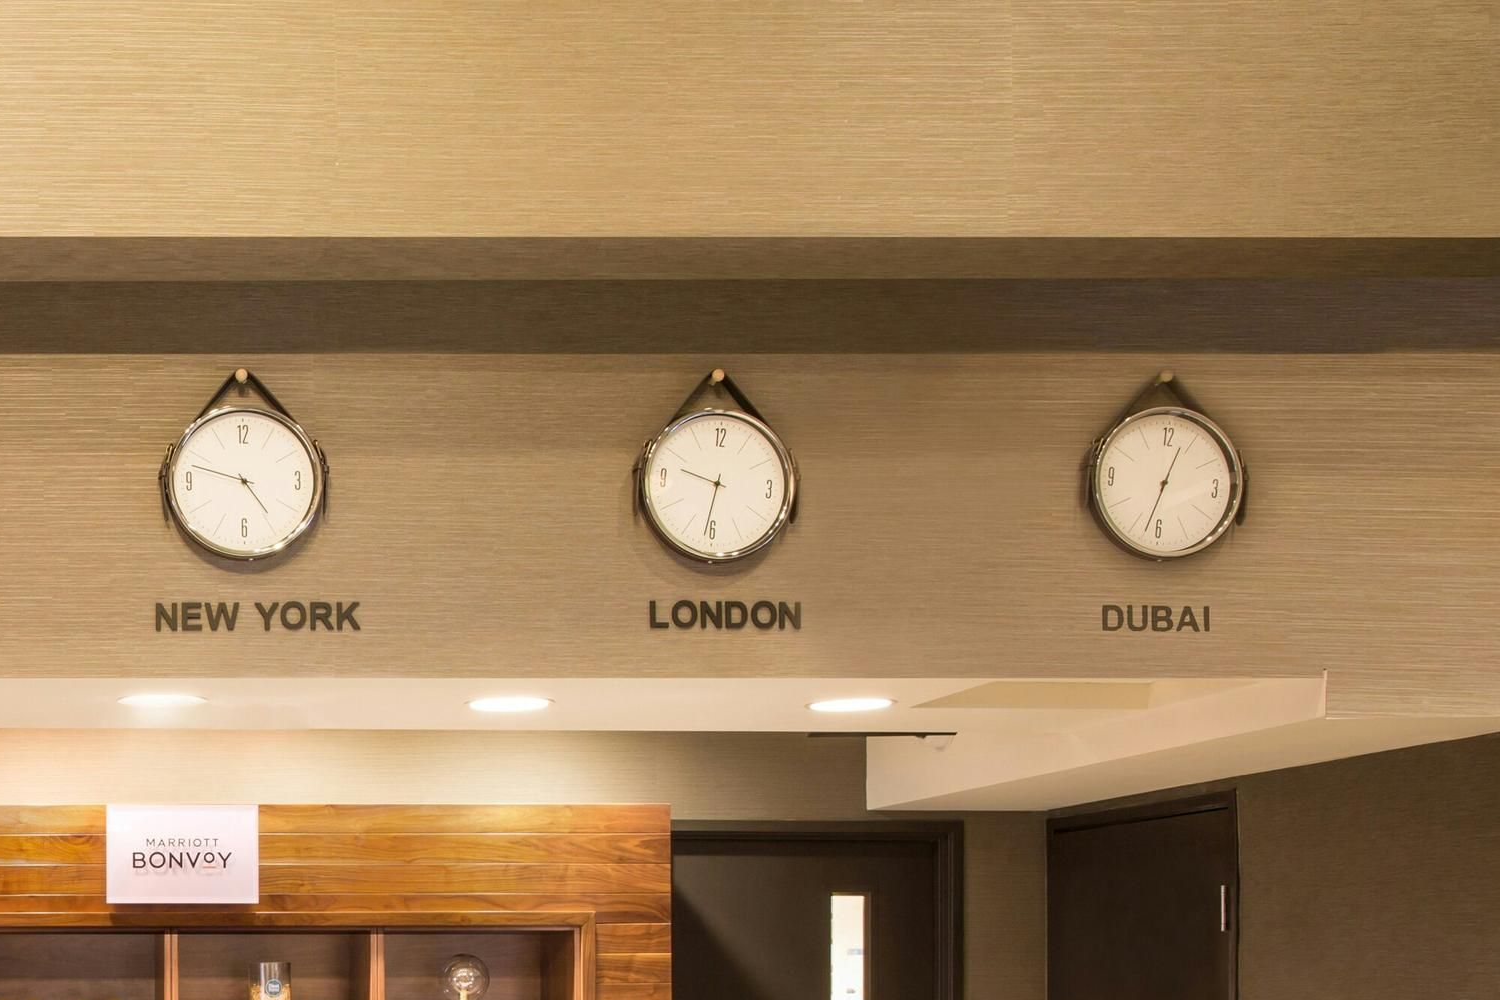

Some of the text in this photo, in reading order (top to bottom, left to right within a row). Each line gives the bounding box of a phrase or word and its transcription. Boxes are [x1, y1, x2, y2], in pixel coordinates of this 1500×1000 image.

[237, 425, 248, 444] 12
[716, 428, 726, 447] 12
[1164, 427, 1174, 446] 12
[186, 471, 192, 491] 9
[295, 471, 301, 490] 3
[661, 468, 667, 487] 9
[1108, 467, 1114, 486] 9
[766, 480, 772, 499] 3
[1211, 479, 1218, 498] 3
[242, 518, 247, 537] 6
[710, 520, 716, 539] 6
[1155, 519, 1162, 538] 6
[154, 601, 361, 632] NEW YORK
[649, 600, 801, 630] LONDON
[1101, 604, 1211, 632] DUBAI
[146, 838, 219, 848] MARRIOTT
[132, 851, 232, 869] BONVOY
